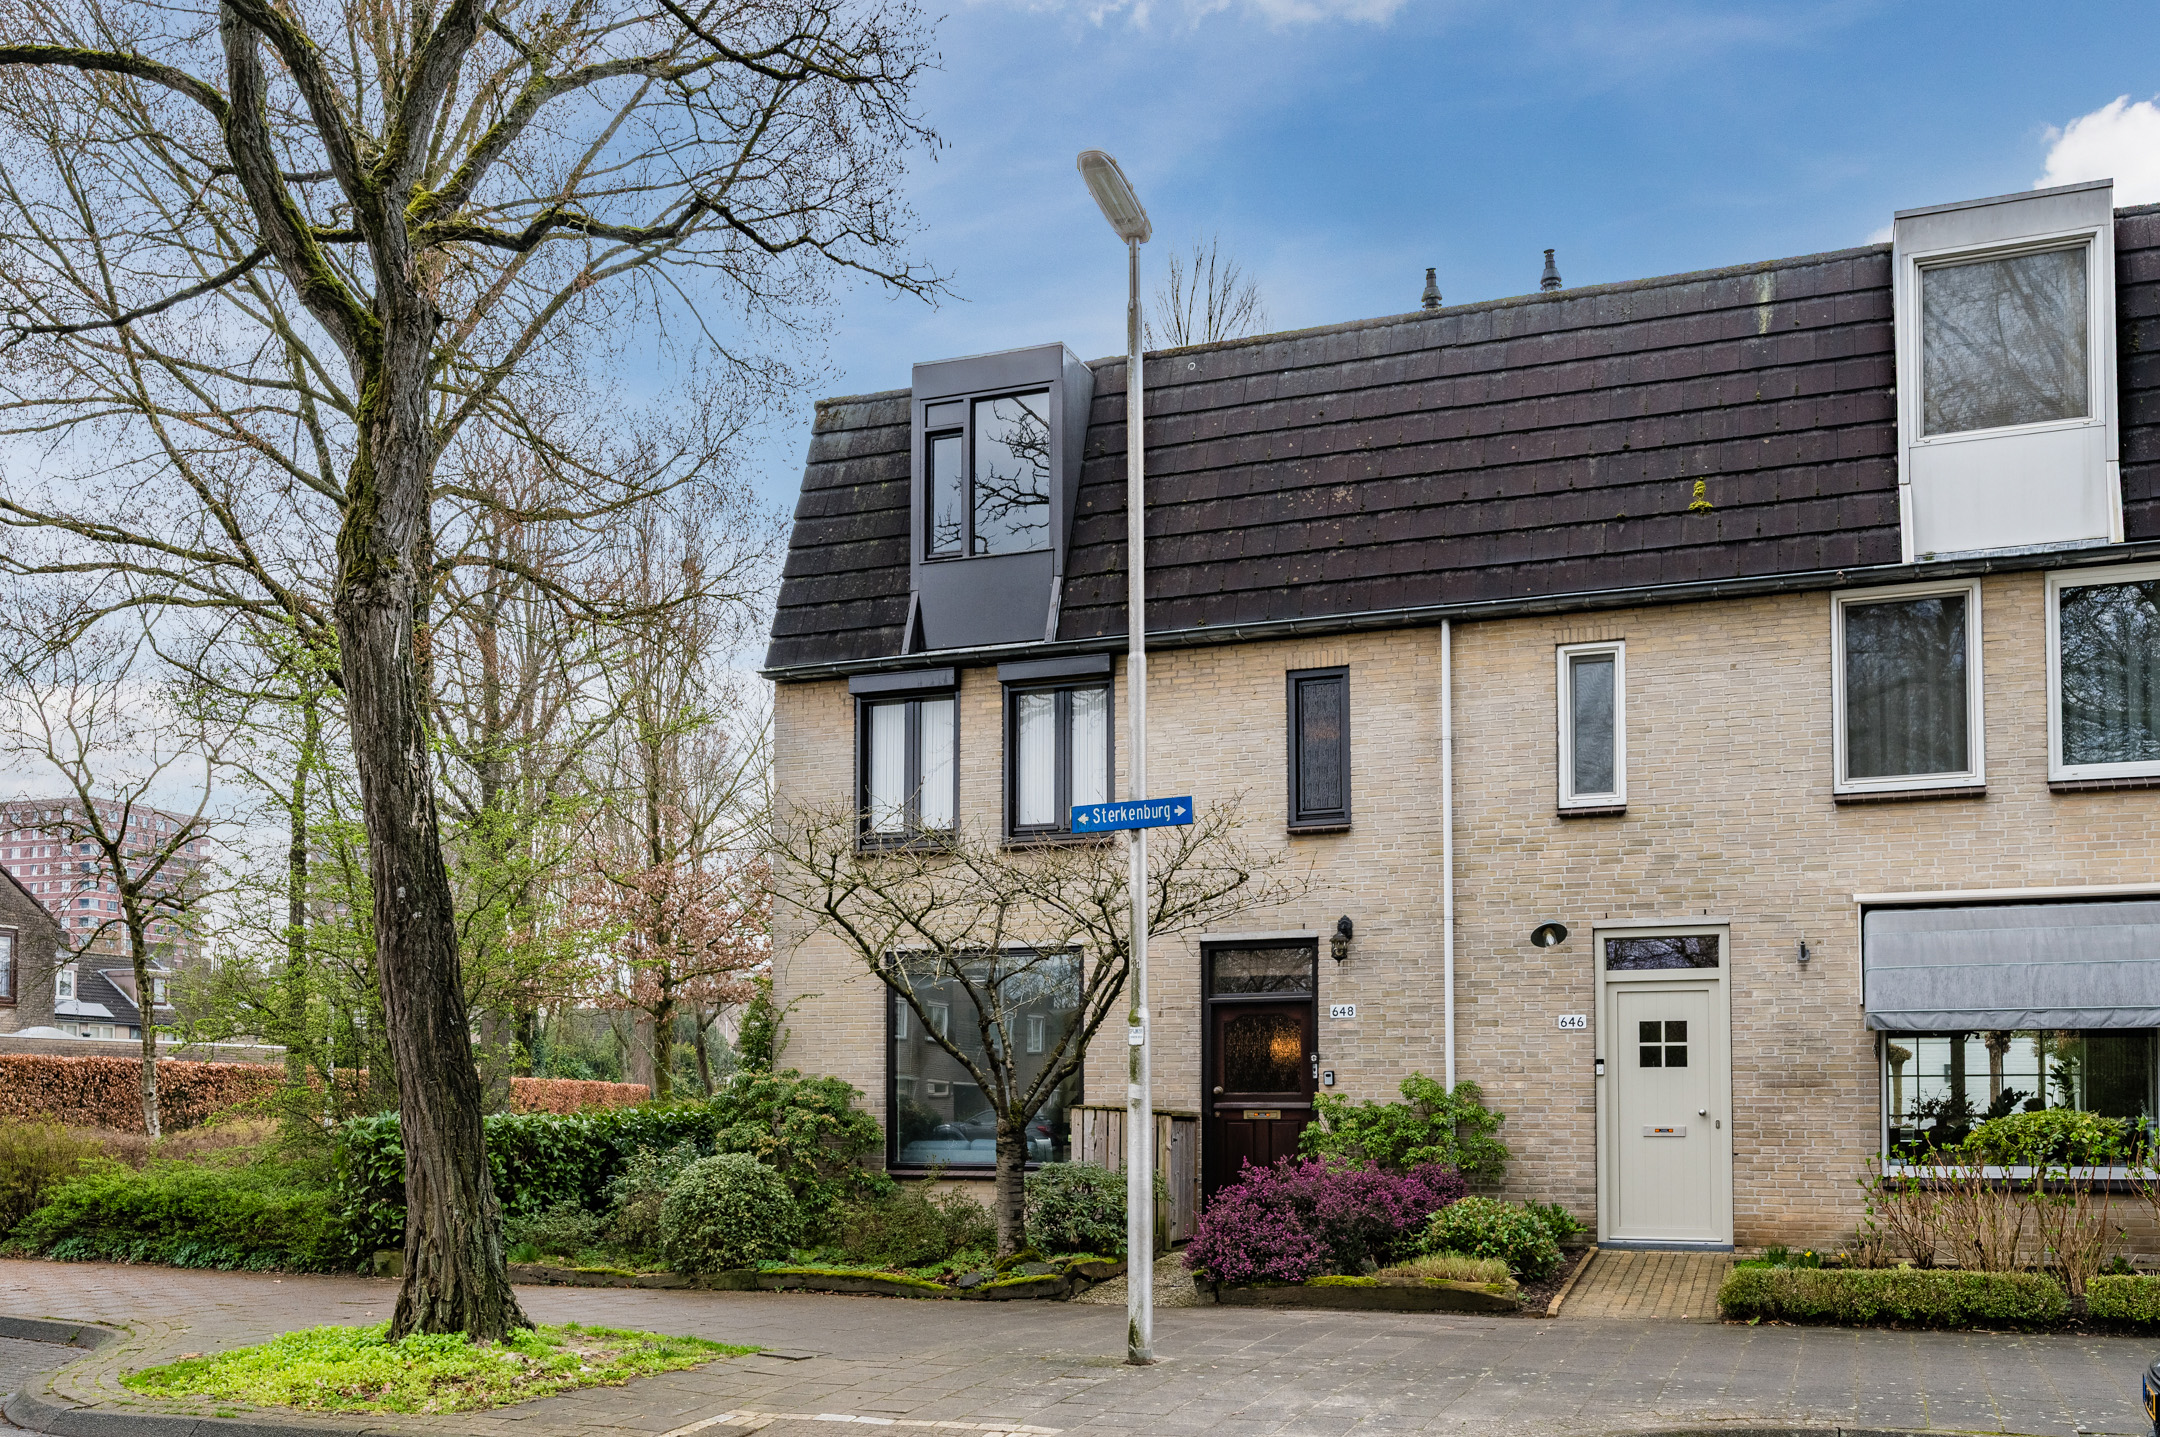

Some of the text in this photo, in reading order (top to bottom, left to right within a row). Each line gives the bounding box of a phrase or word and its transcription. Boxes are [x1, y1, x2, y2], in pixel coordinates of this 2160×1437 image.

[1093, 804, 1170, 824] Sterkenburg
[1332, 1006, 1354, 1017] 648
[1560, 1016, 1584, 1028] 646
